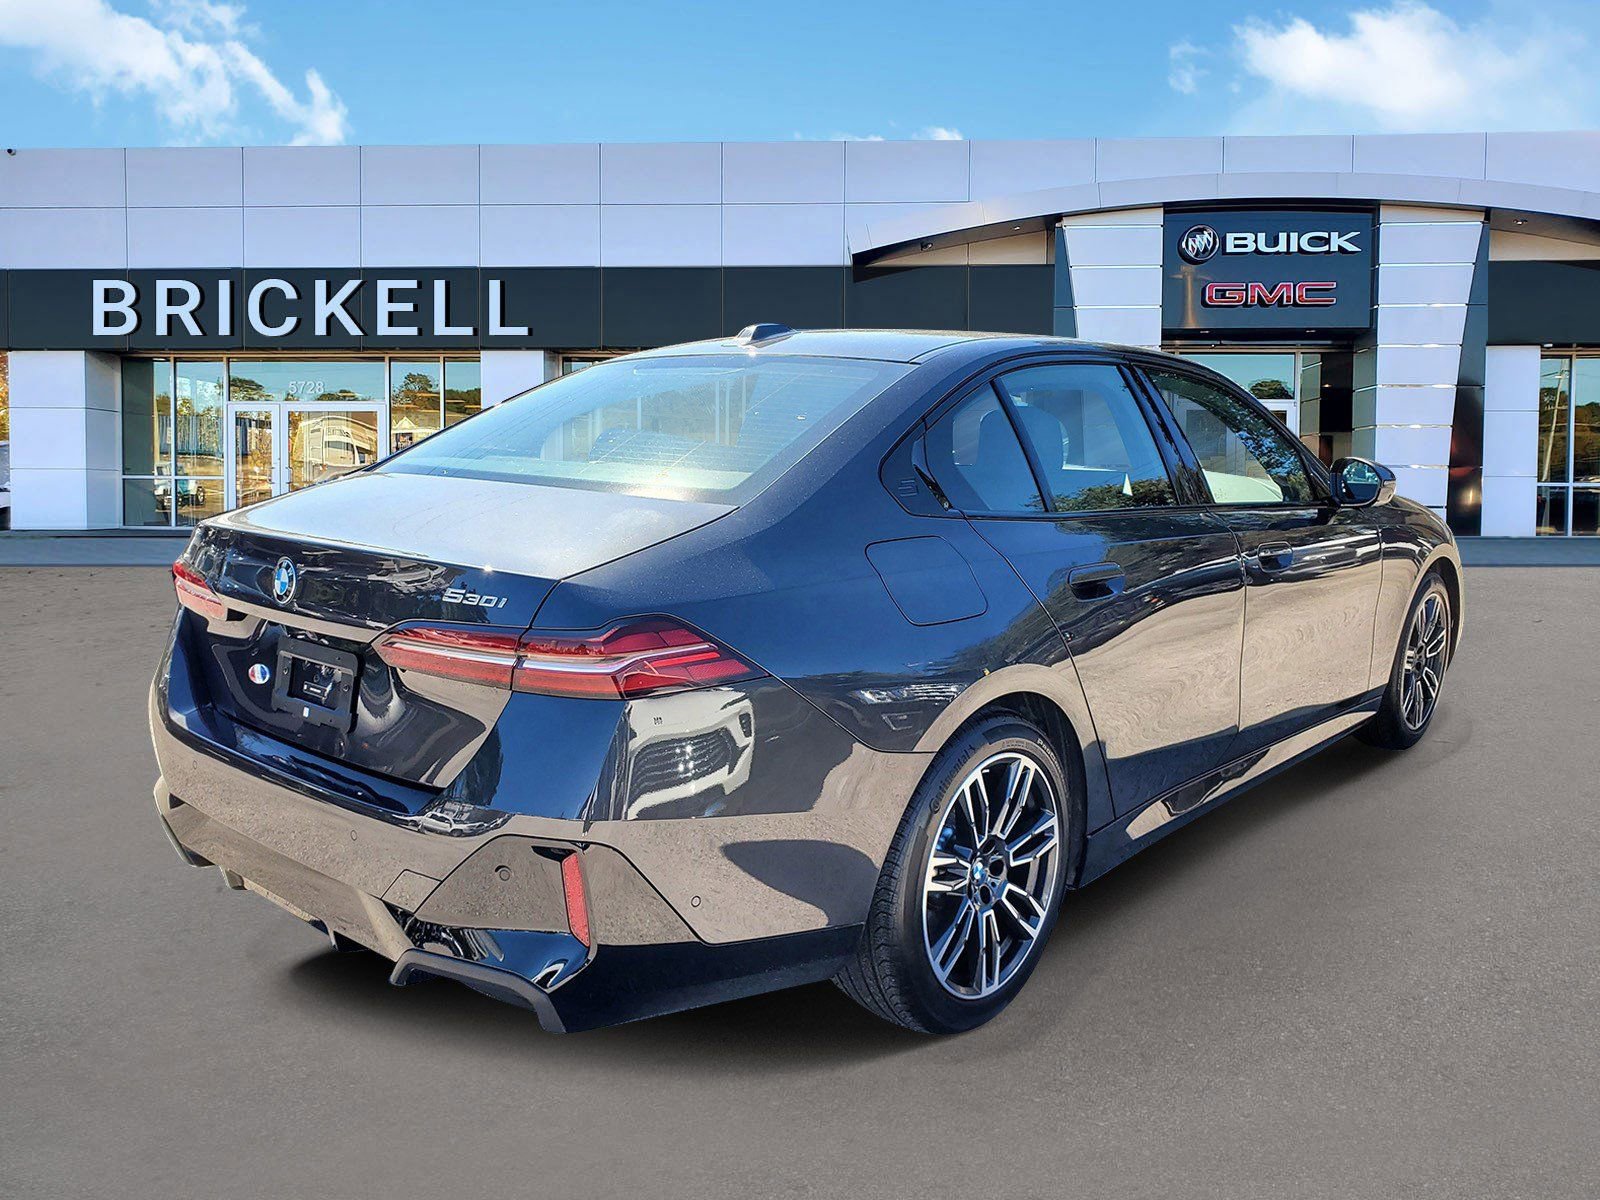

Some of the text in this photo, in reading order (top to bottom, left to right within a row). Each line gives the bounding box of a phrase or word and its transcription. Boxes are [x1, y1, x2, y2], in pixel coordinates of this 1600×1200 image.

[1225, 231, 1362, 253] BUICK
[1205, 281, 1337, 305] GMC
[92, 278, 529, 337] BRICKELL
[288, 380, 325, 395] 5728
